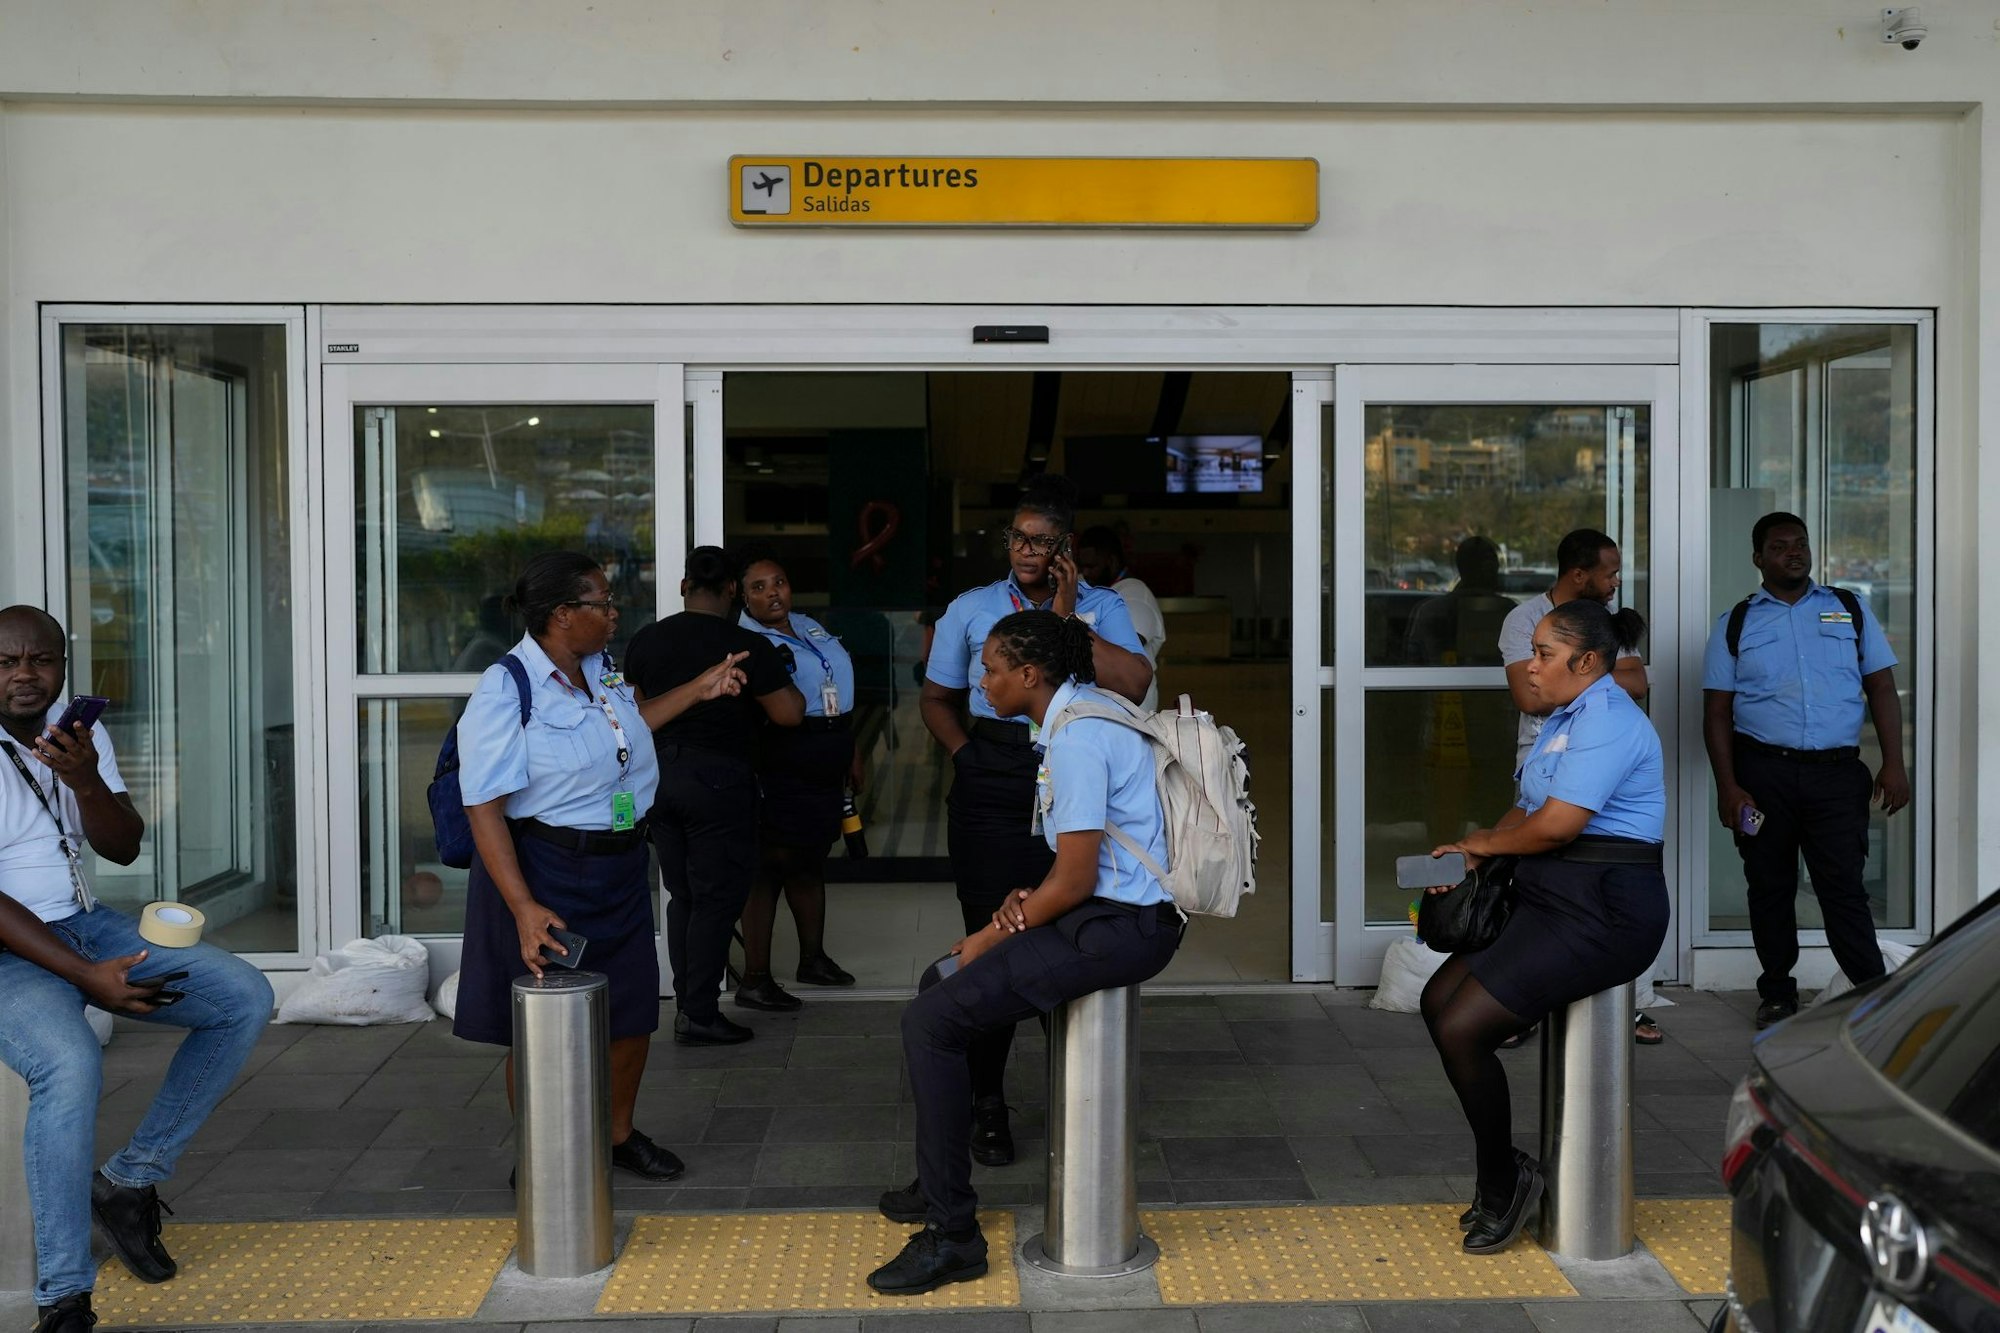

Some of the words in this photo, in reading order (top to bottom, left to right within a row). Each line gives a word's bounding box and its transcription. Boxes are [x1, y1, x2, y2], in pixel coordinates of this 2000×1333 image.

[804, 161, 978, 194] Departures
[803, 195, 870, 212] Salidas
[12, 754, 26, 770] SITA
[31, 780, 43, 796] SITA
